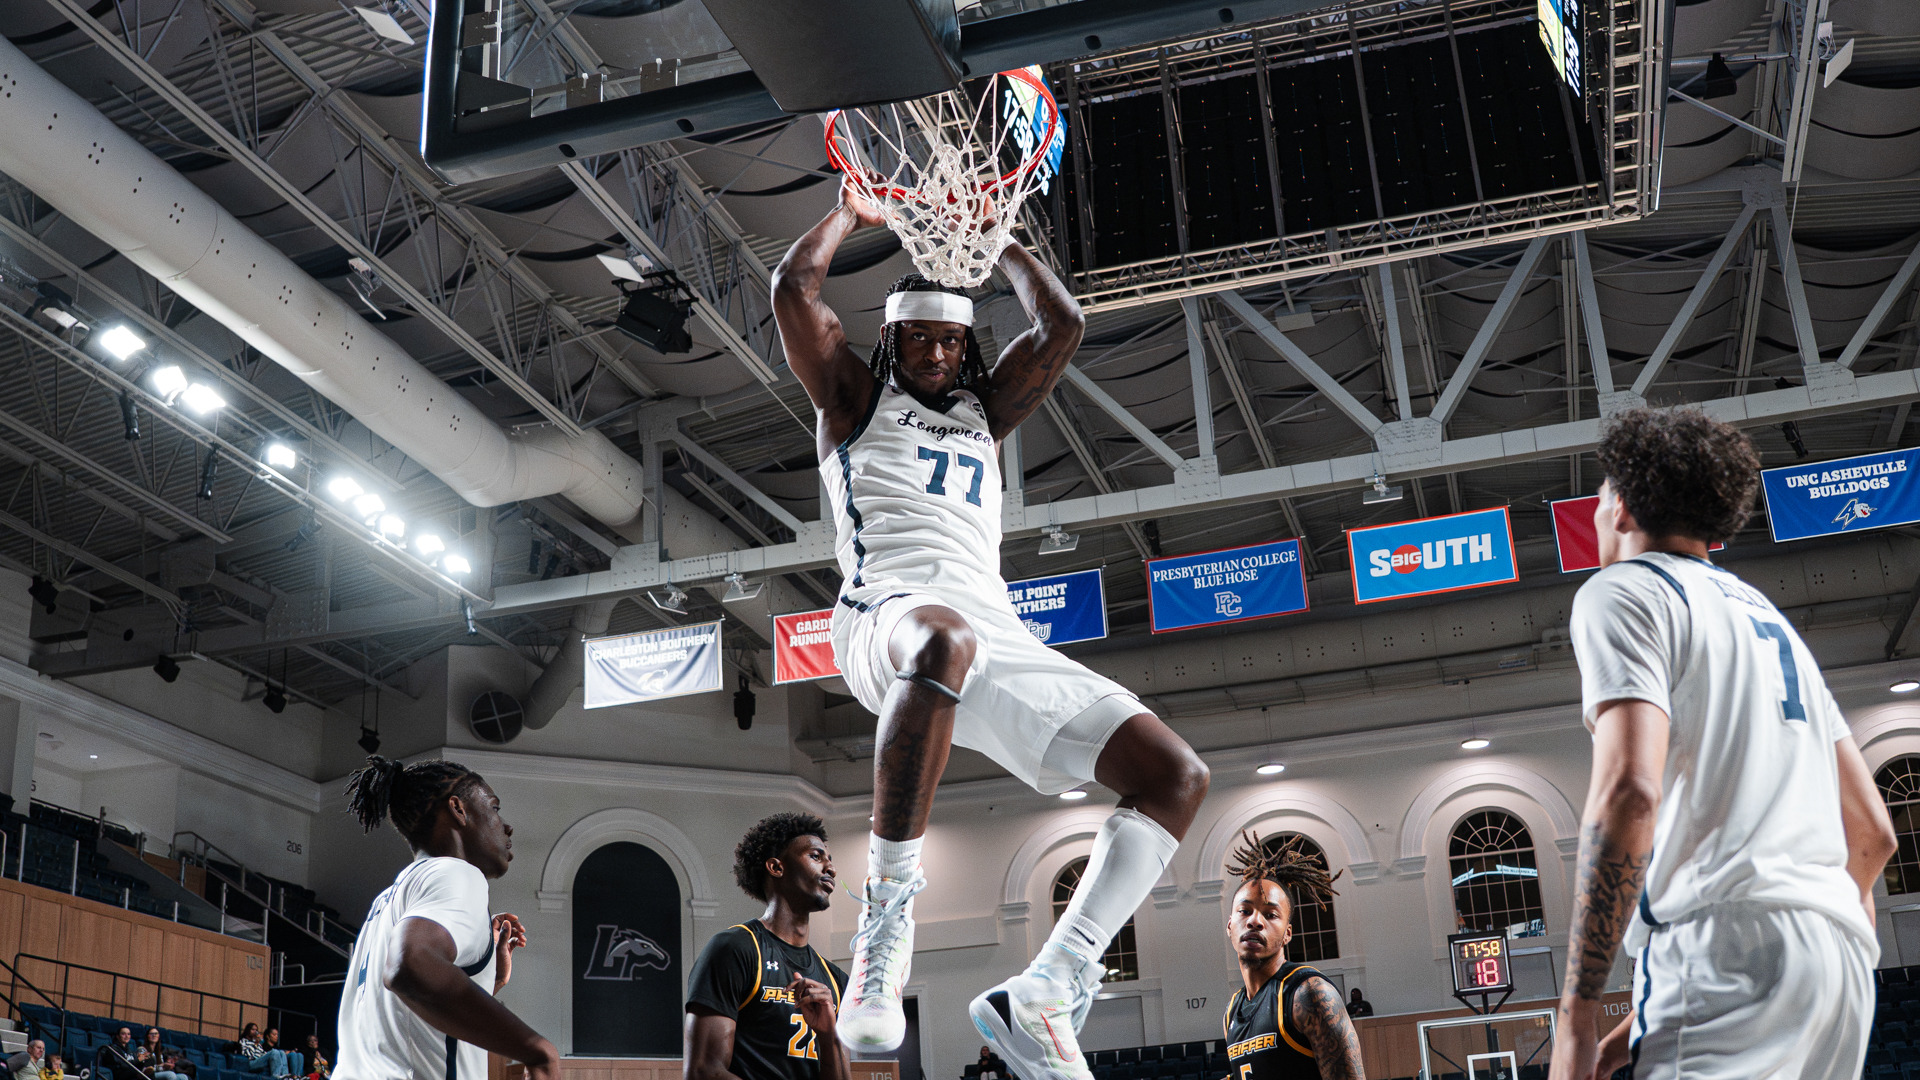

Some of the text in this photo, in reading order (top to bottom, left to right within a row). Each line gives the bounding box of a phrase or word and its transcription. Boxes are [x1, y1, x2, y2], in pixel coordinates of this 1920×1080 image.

[1003, 89, 1034, 160] 17:58
[914, 444, 984, 508] 77
[1785, 459, 1907, 489] UNC ASHEVILLE
[1808, 476, 1890, 499] BULLDOGS
[1153, 550, 1297, 583] PRESBYTERIAN COLLEGE
[1391, 551, 1423, 568] BIG
[1193, 568, 1259, 590] BLUE HOSE
[1026, 583, 1068, 600] POINT
[592, 632, 715, 661] CHARLESTON SOUTHERN
[619, 649, 688, 669] BUCCANEERS
[1746, 613, 1808, 723] 7
[287, 840, 302, 855] 206
[1463, 940, 1500, 959] 17:58
[1475, 958, 1500, 986] 18
[1186, 997, 1207, 1009] 107
[1602, 1002, 1630, 1017] 108
[1227, 1032, 1278, 1061] FEIFFER
